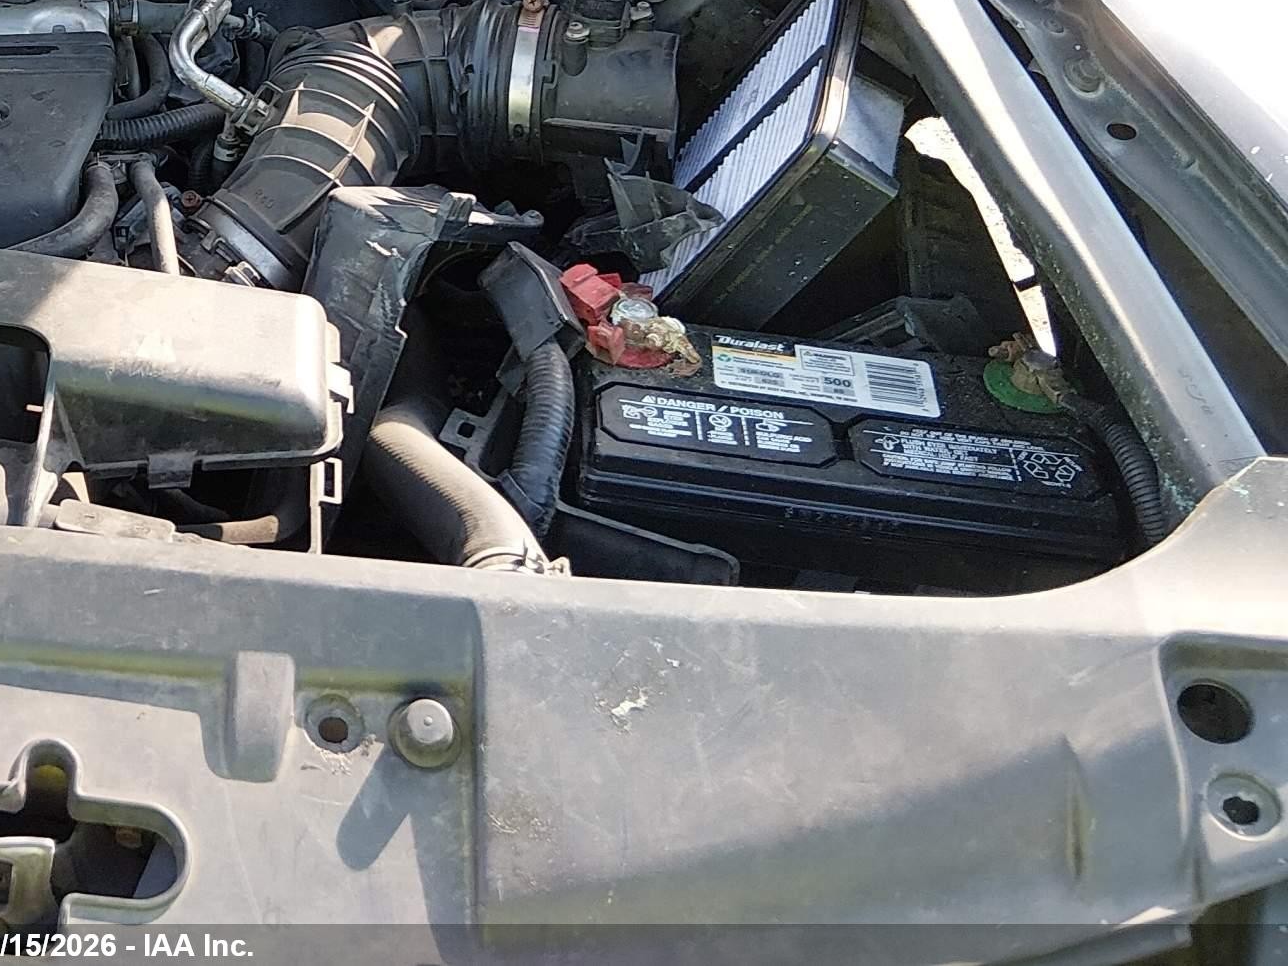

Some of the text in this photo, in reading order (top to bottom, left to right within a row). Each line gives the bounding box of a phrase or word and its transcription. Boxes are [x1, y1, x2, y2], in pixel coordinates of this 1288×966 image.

[715, 335, 786, 352] Duralast
[823, 376, 852, 388] 500
[656, 397, 717, 411] DANGER
[730, 406, 785, 419] POISON
